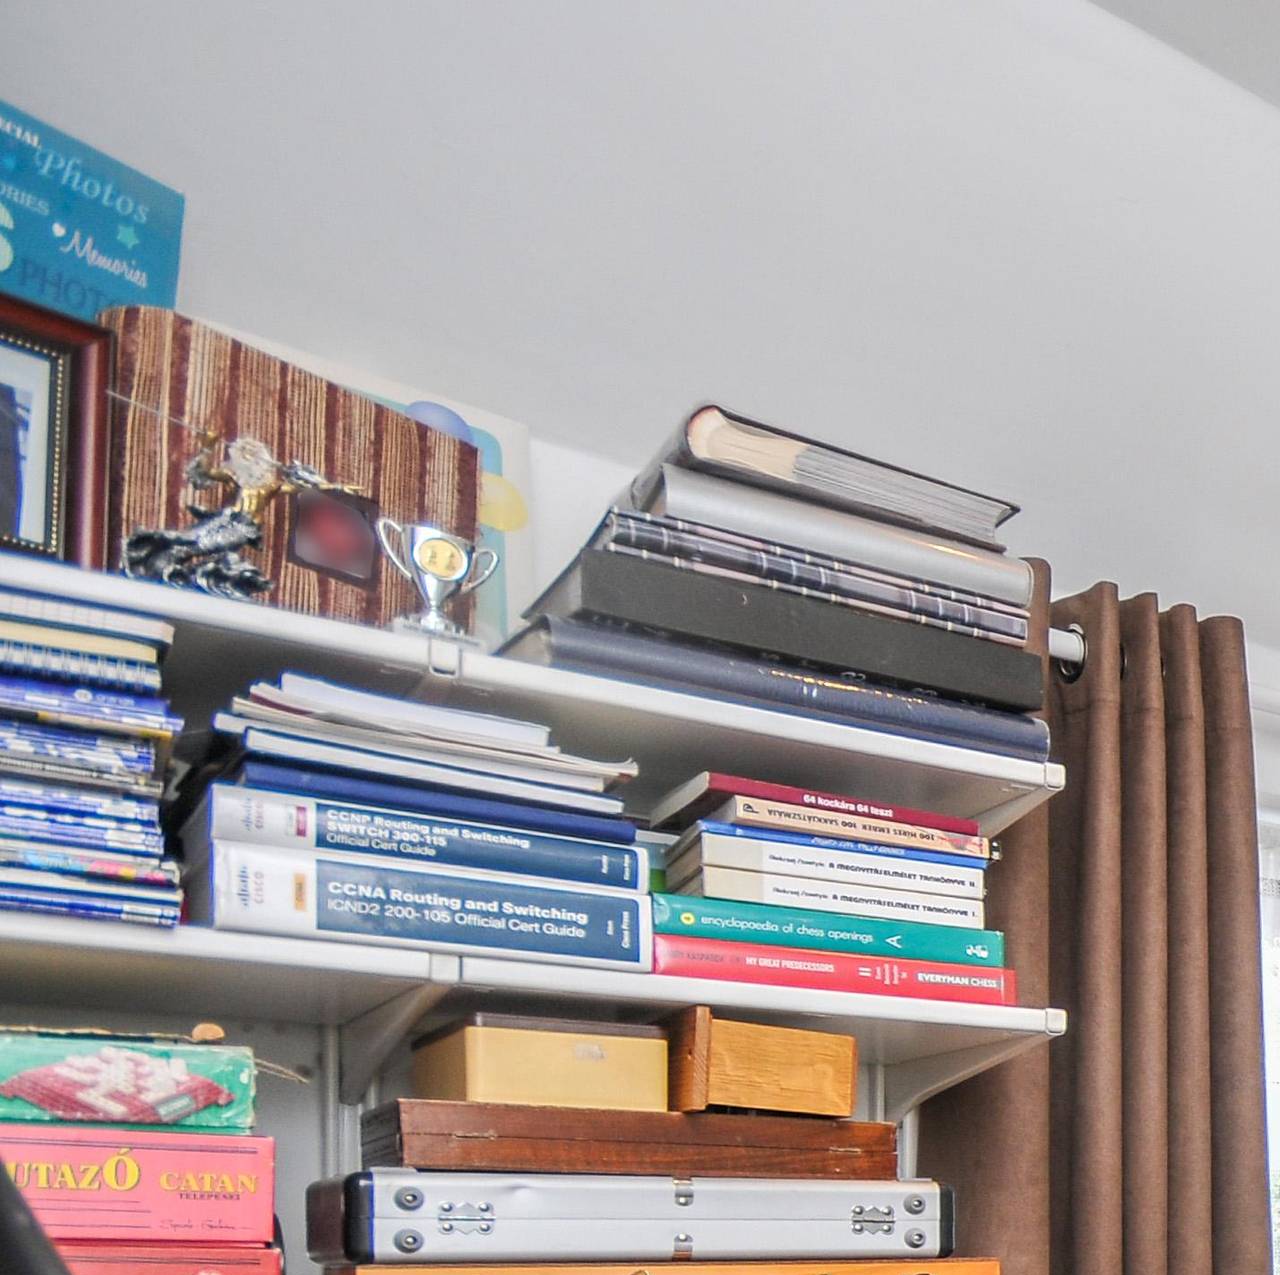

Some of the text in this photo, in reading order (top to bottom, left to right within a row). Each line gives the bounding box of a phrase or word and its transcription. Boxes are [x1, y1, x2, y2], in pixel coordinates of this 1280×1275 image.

[34, 148, 150, 224] Photos
[60, 229, 148, 289] Memories
[803, 794, 815, 805] 64
[817, 796, 855, 813] kockára
[856, 803, 869, 814] 64
[326, 809, 531, 849] CCNP Routing and Switching
[326, 820, 447, 847] SWITCH 300-115
[840, 820, 856, 829] 100
[326, 832, 436, 857] Official Cert Guide
[327, 881, 589, 925] CCNA Routing and Switching
[327, 898, 381, 916] ICND2
[454, 912, 506, 930] Official
[508, 919, 541, 935] Cert
[542, 922, 586, 939] Guide
[701, 914, 778, 934] encyclopaedia
[782, 921, 794, 935] of
[796, 922, 824, 938] chess
[828, 928, 874, 945] openings
[917, 972, 968, 987] EVERYMAN
[159, 1171, 258, 1193] CATAN
